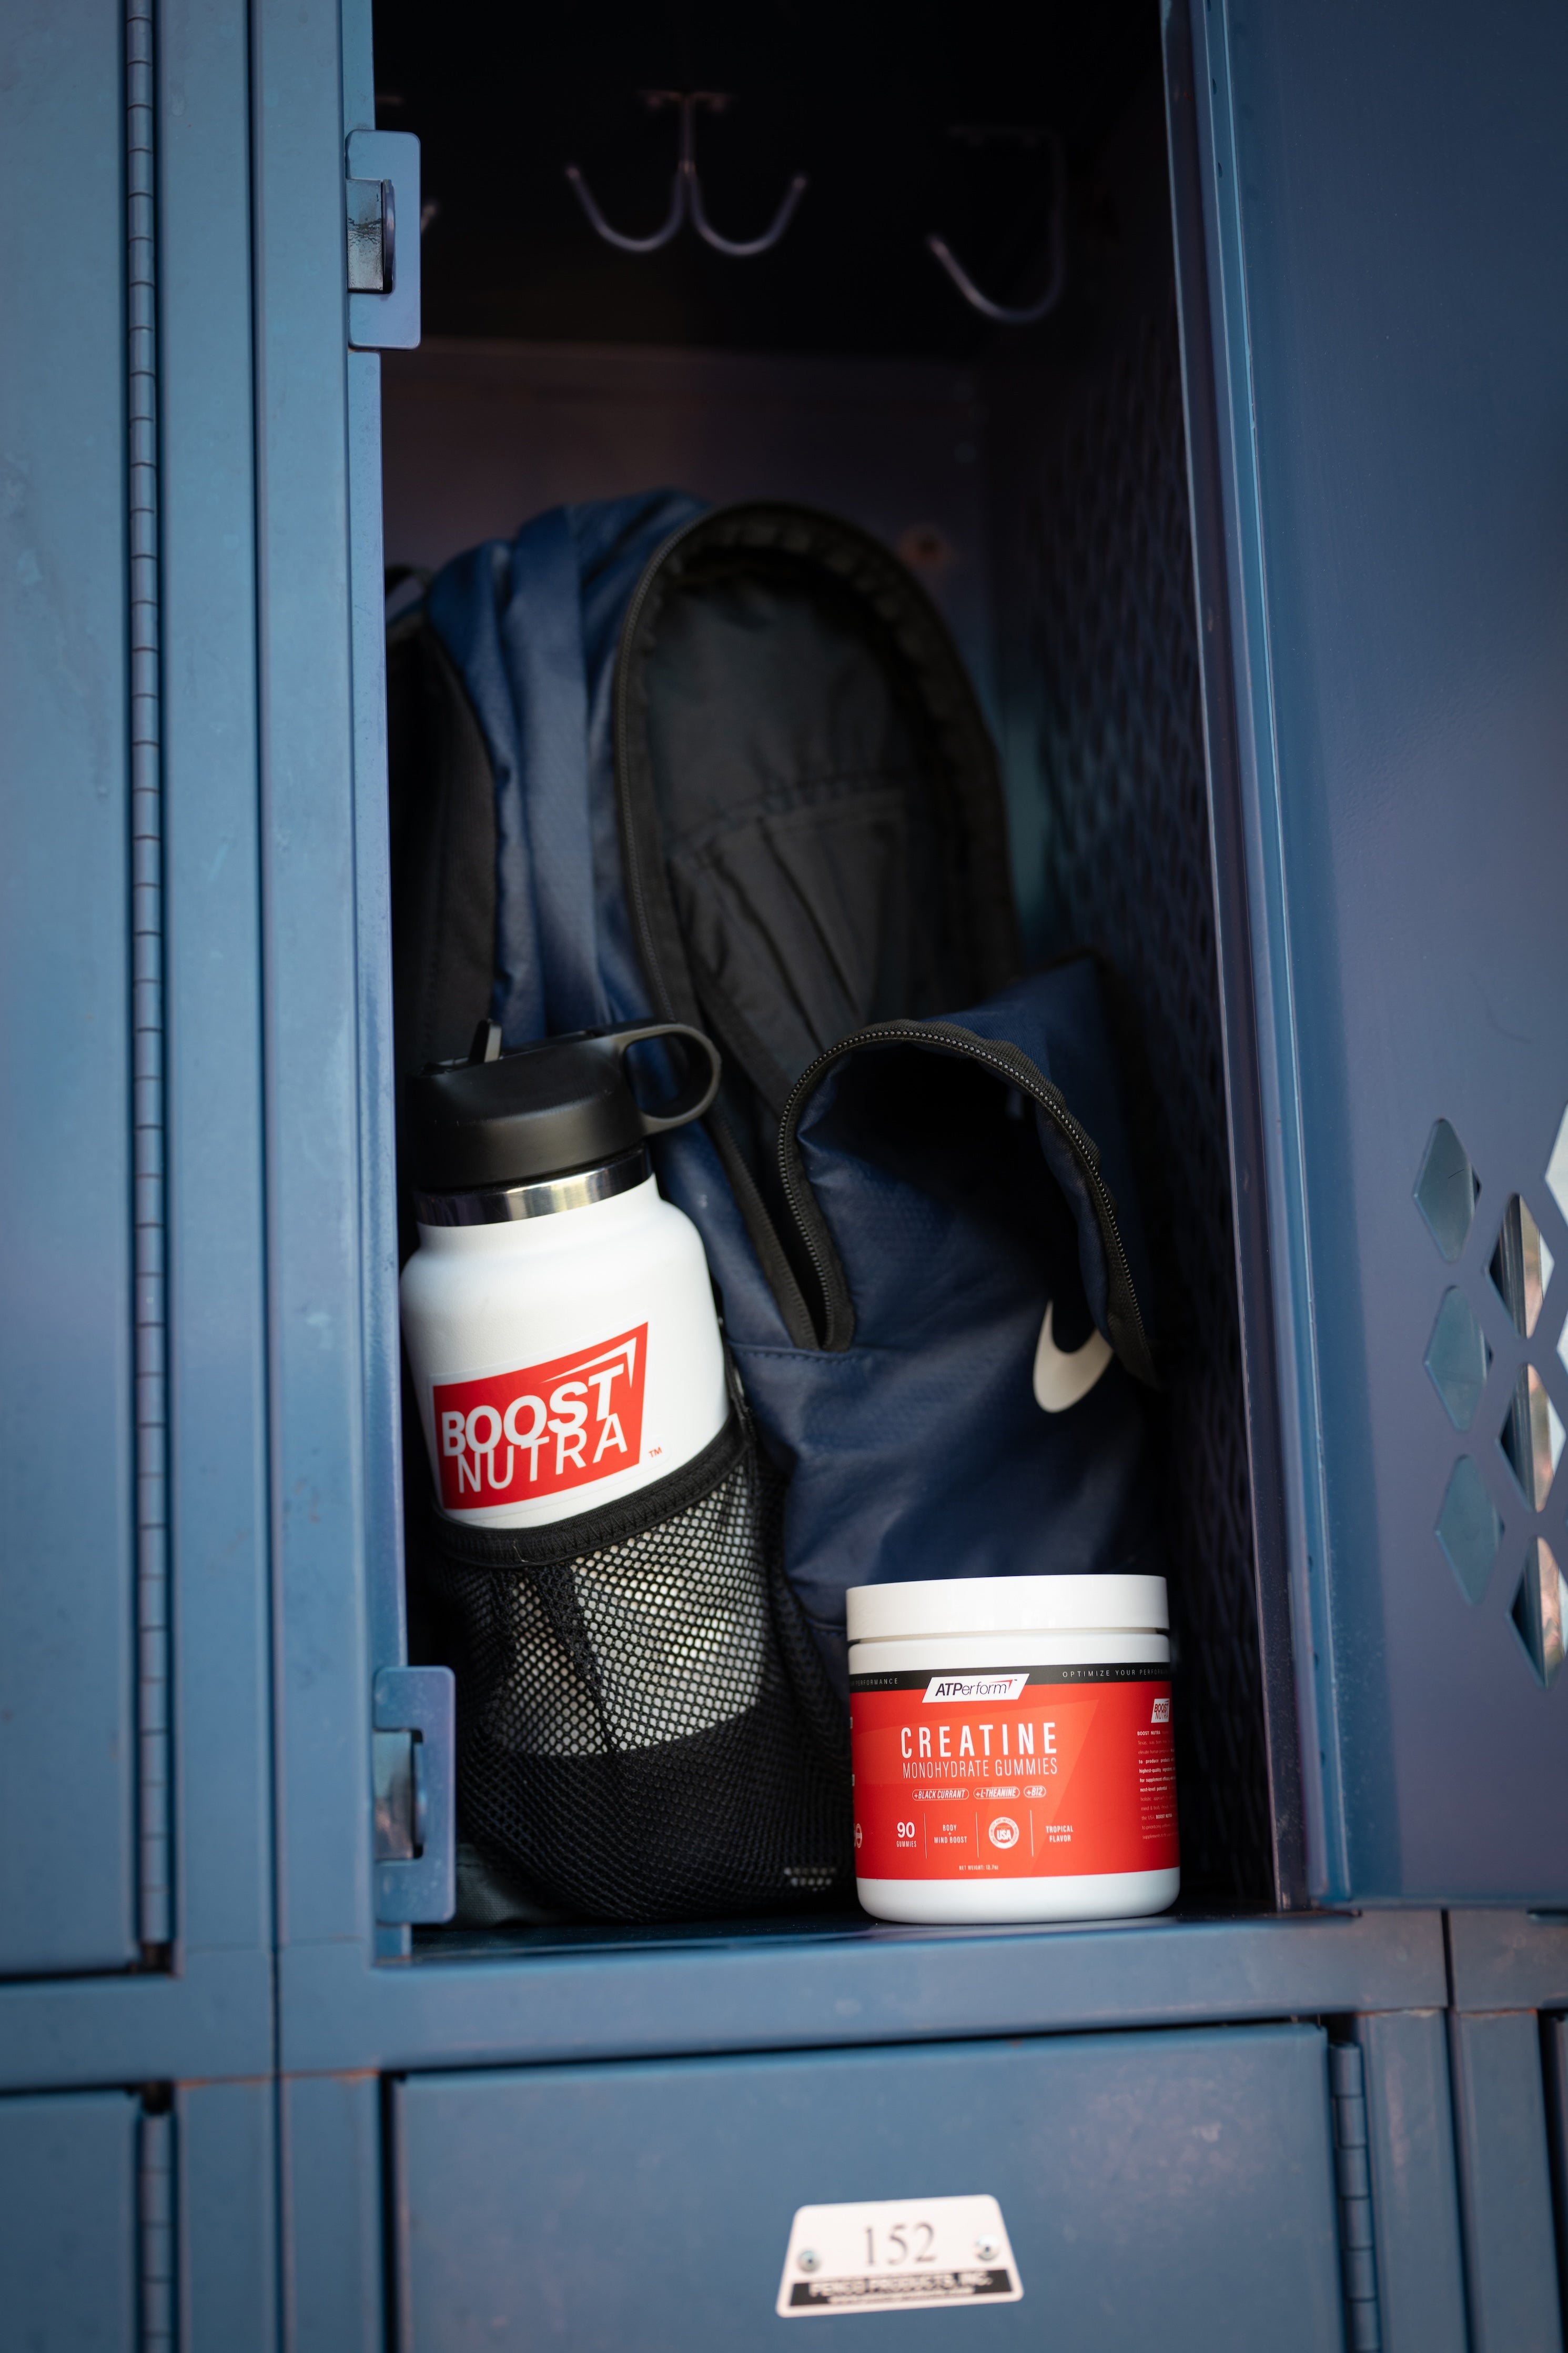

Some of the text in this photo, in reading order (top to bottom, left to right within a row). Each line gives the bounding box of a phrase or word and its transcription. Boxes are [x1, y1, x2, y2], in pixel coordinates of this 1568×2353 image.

[442, 1363, 624, 1456] BOOST
[457, 1413, 628, 1494] NUTRA
[648, 1446, 663, 1458] TM
[935, 1681, 1007, 1696] ATPerform
[1154, 1703, 1169, 1713] BOOST
[901, 1722, 1057, 1758] CREATINE
[903, 1757, 1057, 1779] MONOHYDRATE GUMMIES
[914, 1789, 966, 1799] +BLACK CURRANT
[1026, 1787, 1043, 1796] +B12
[897, 1822, 915, 1838] 90
[996, 1829, 1012, 1841] USA
[1045, 1825, 1074, 1834] TROPICAL
[1049, 1834, 1071, 1843] FLAVOR
[864, 2221, 936, 2266] 152
